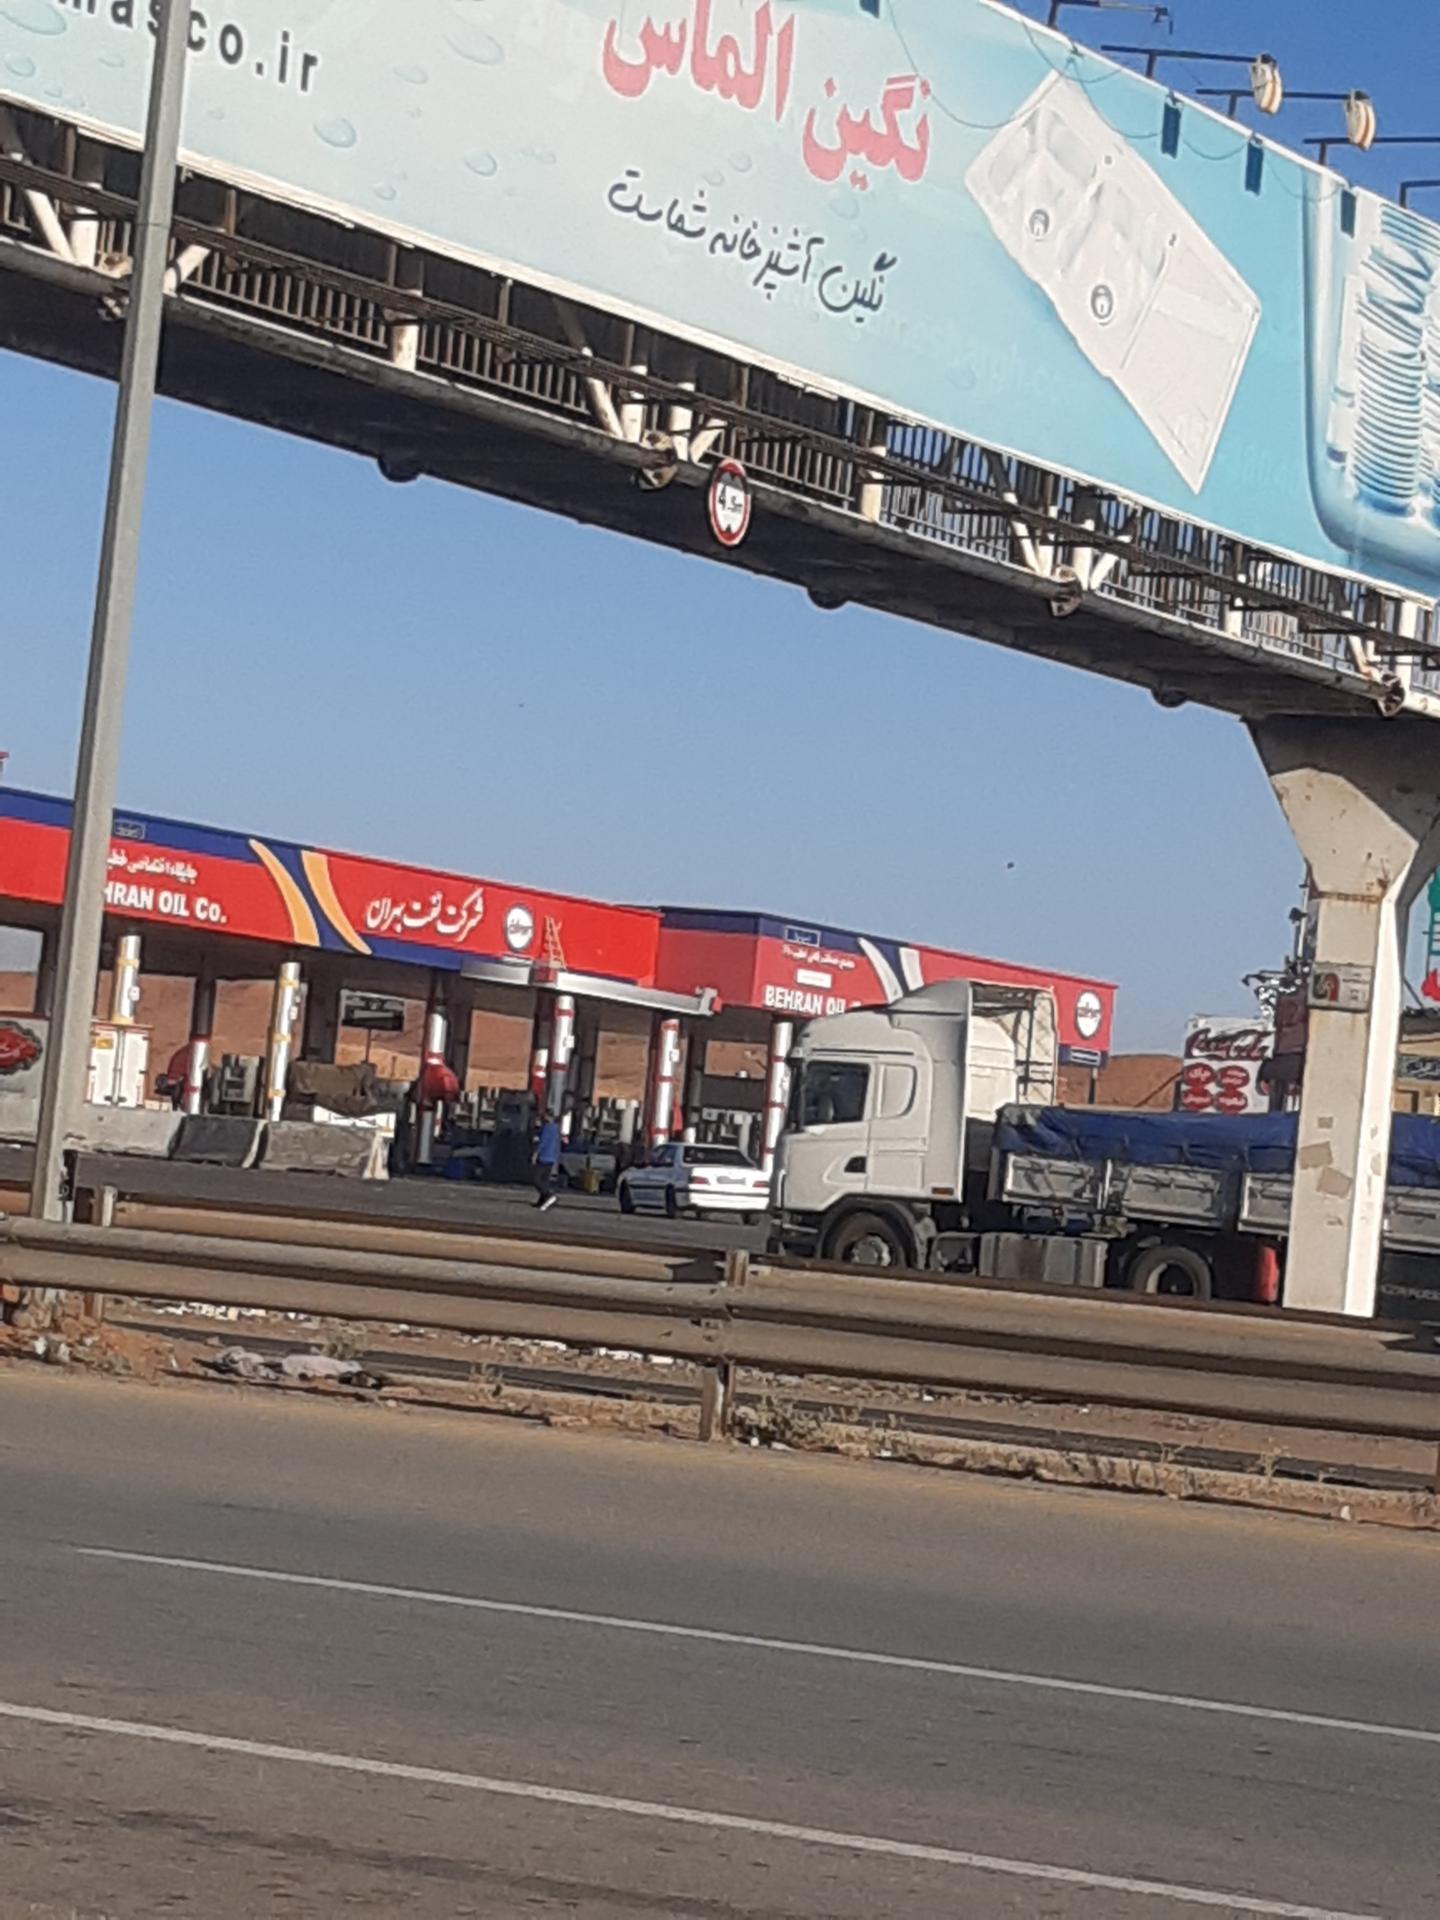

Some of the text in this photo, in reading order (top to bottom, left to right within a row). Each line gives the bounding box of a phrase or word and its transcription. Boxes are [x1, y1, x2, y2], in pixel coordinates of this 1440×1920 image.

[602, 0, 931, 191] نگین الماس
[607, 169, 707, 239] شماست
[818, 252, 897, 323] نگین
[103, 881, 227, 924] HRAN OIL Co.
[366, 897, 406, 933] بهران
[402, 891, 443, 928] نفت
[436, 887, 484, 943] شرکت
[764, 984, 823, 1015] BEHRAN
